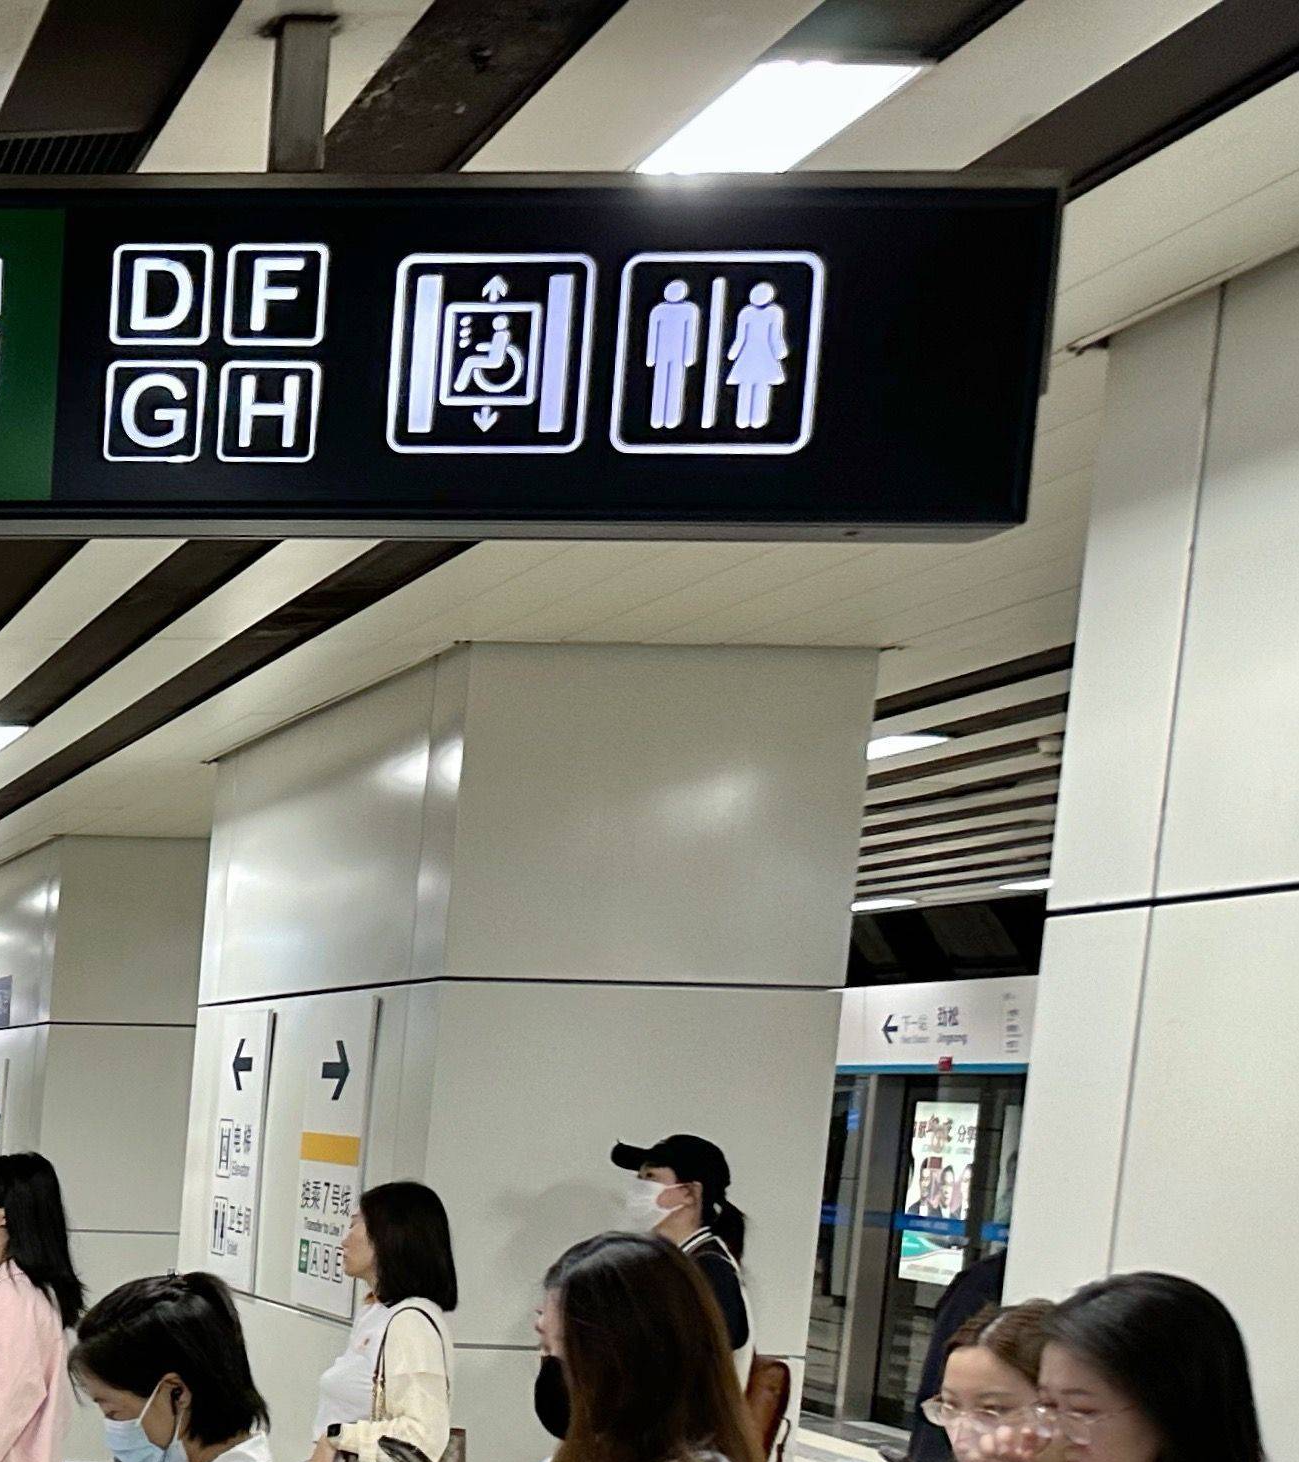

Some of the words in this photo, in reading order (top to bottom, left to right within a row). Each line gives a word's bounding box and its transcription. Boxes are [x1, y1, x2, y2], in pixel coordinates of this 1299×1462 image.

[129, 256, 195, 331] D
[249, 257, 306, 331] F
[120, 372, 188, 449] G
[237, 374, 300, 448] H
